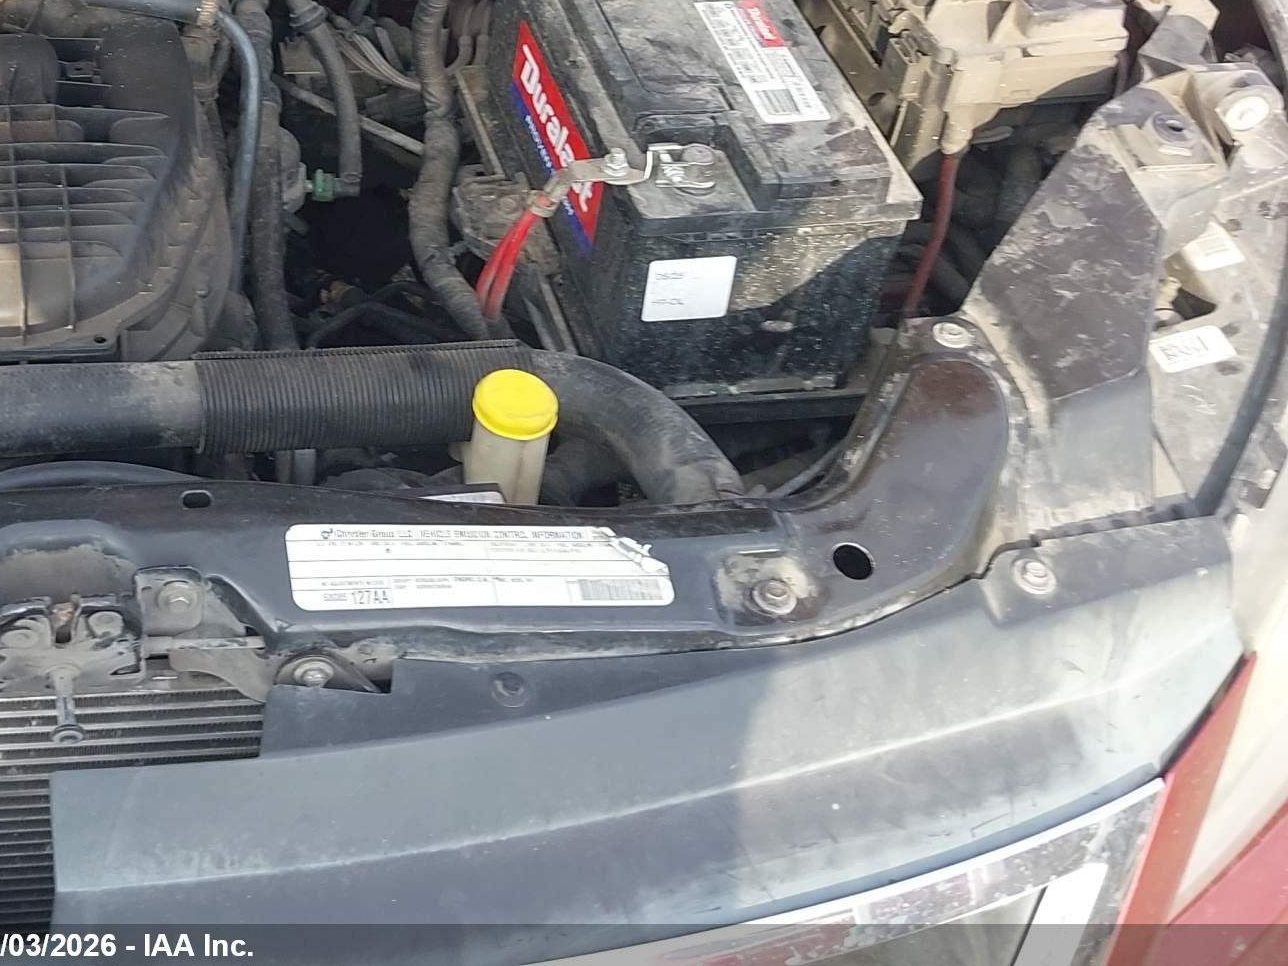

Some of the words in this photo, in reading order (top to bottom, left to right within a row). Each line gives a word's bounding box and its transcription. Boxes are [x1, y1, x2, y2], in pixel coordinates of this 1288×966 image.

[493, 531, 528, 539] CONTROL
[531, 531, 583, 540] INFORMATION
[352, 589, 391, 605] 127AA
